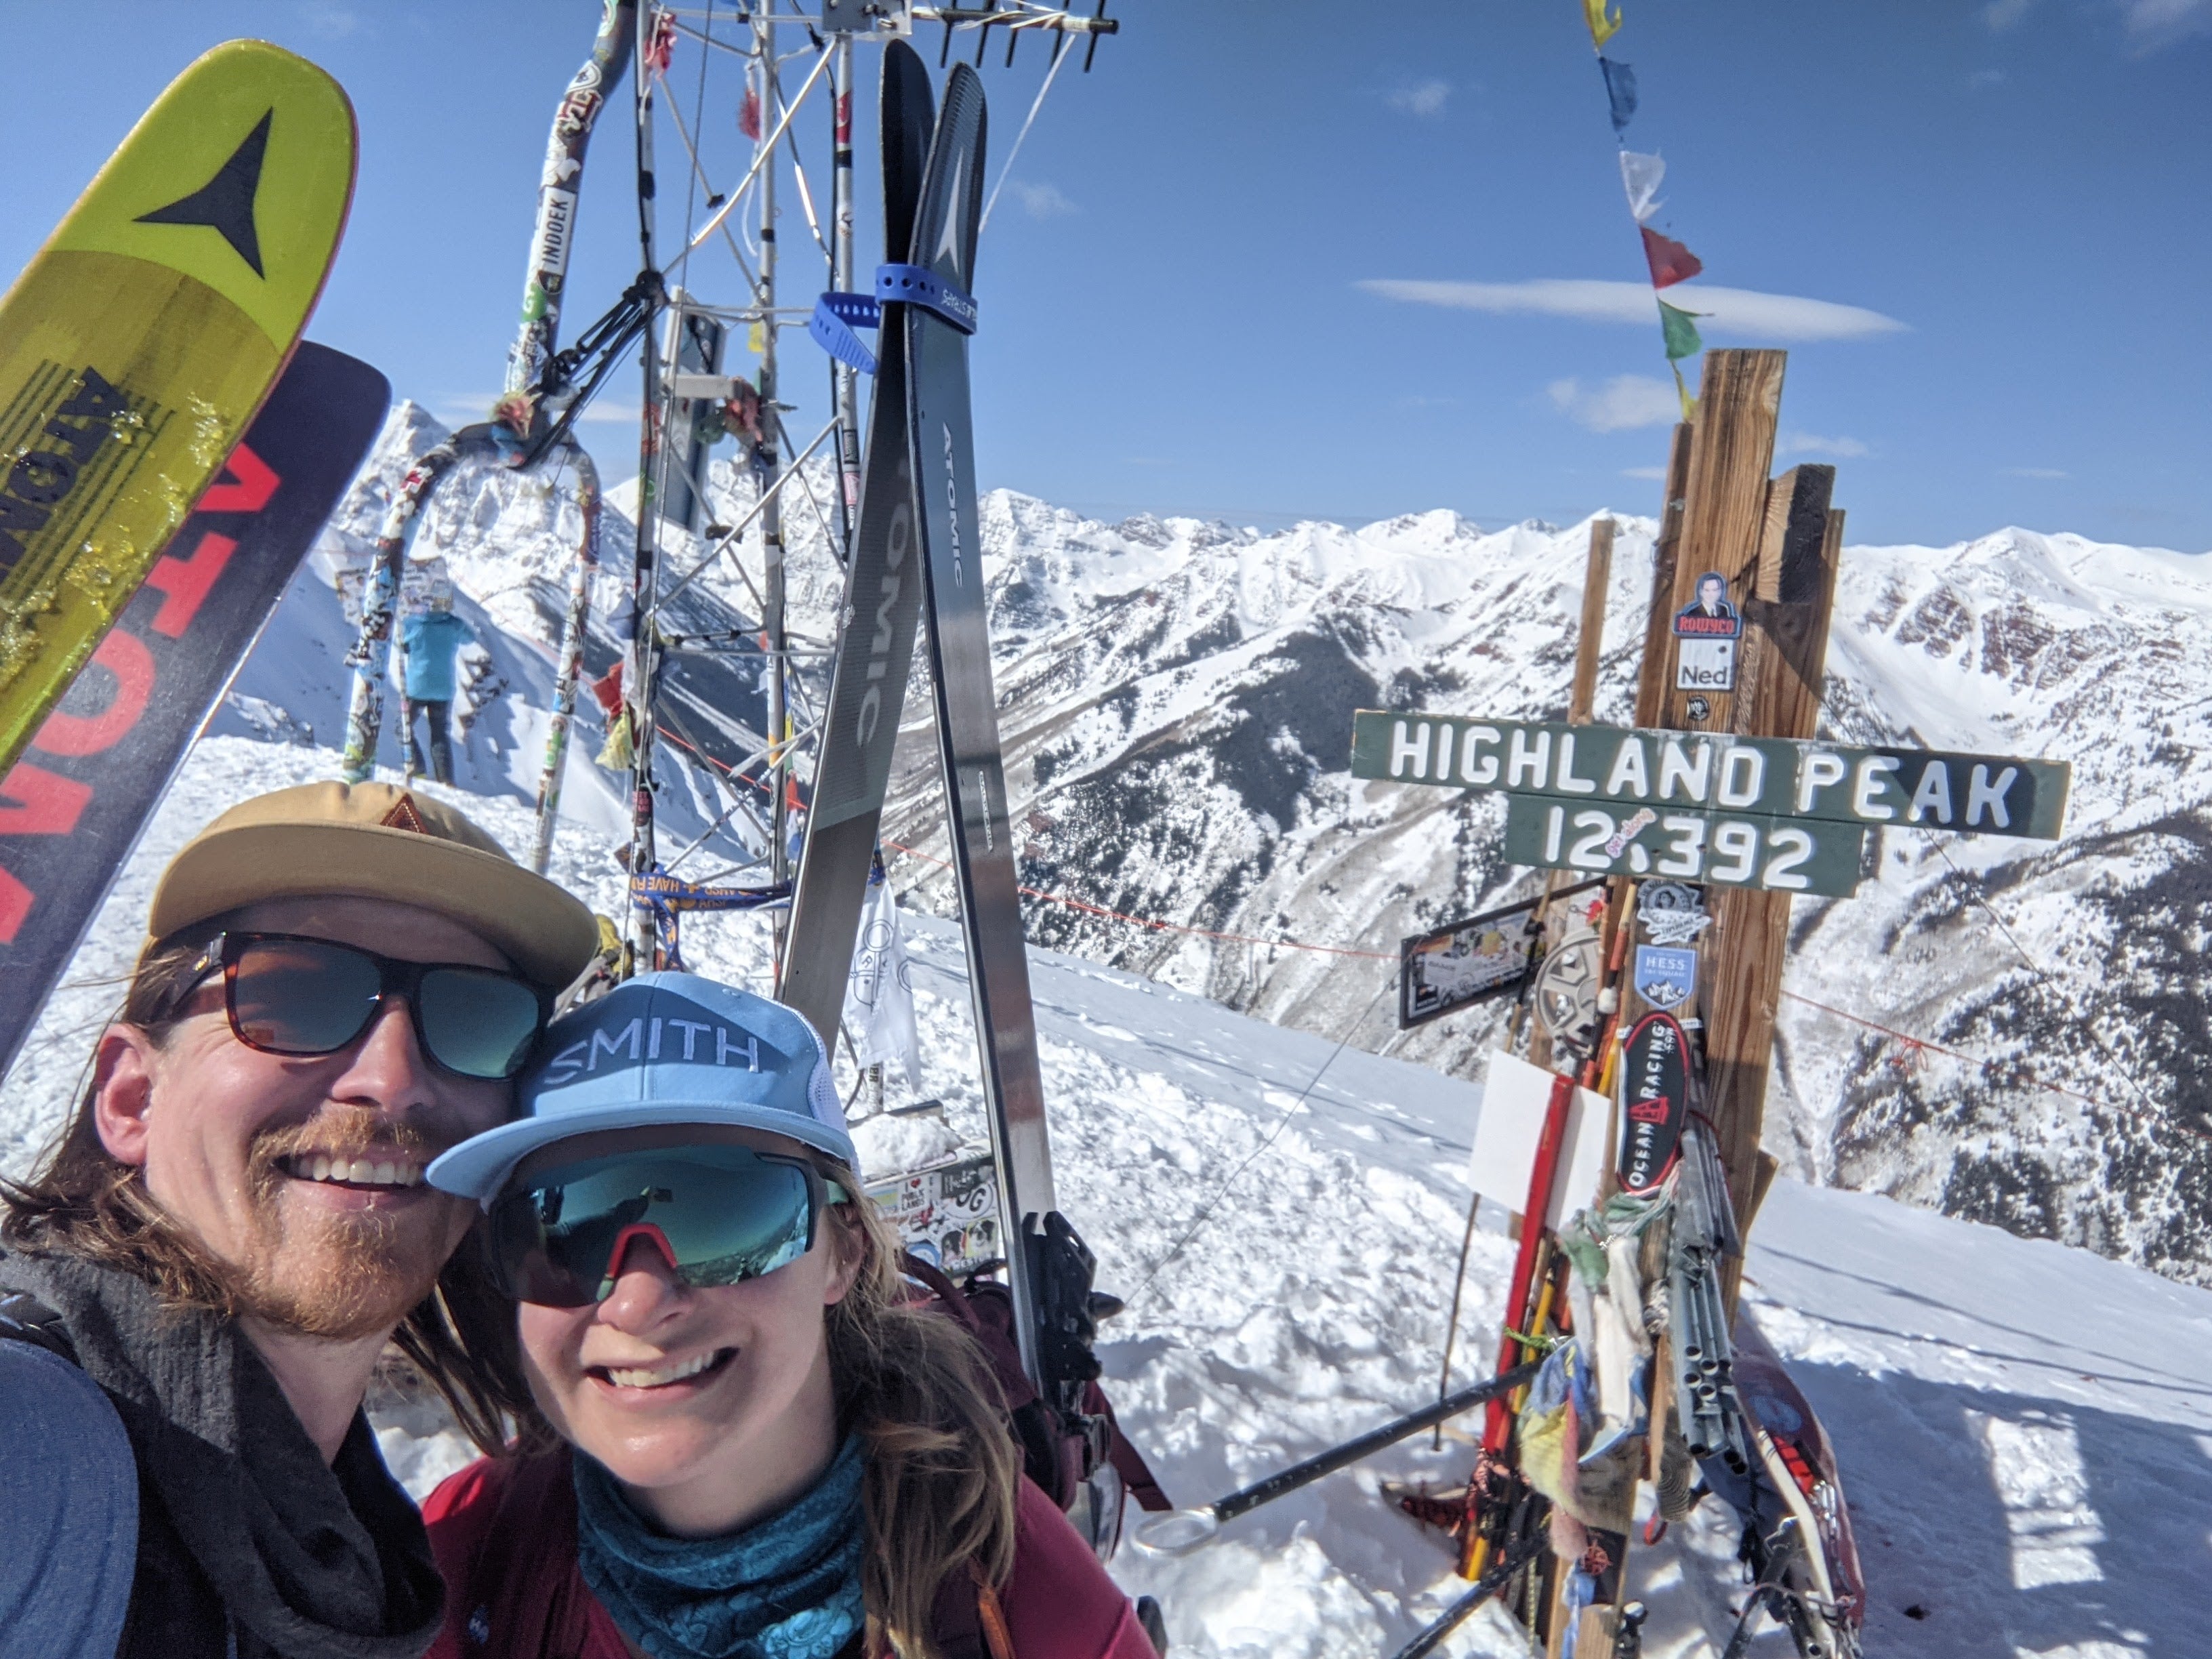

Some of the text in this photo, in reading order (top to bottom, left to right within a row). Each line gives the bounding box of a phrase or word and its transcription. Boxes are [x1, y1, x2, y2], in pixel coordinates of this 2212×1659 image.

[542, 199, 567, 265] INDOEK
[0, 366, 129, 581] ATOM
[942, 422, 965, 588] ATOMIC
[857, 468, 911, 748] OMIC
[1678, 615, 1735, 634] ROWYCO
[1681, 665, 1727, 684] Ned
[1389, 720, 2018, 828] HIGHLAND PEAK
[647, 876, 680, 893] HAVE
[1545, 805, 1814, 890] 12,392
[1645, 956, 1686, 970] HESS
[544, 1017, 760, 1084] SMITH
[1628, 1025, 1666, 1187] OCEAN RACING
